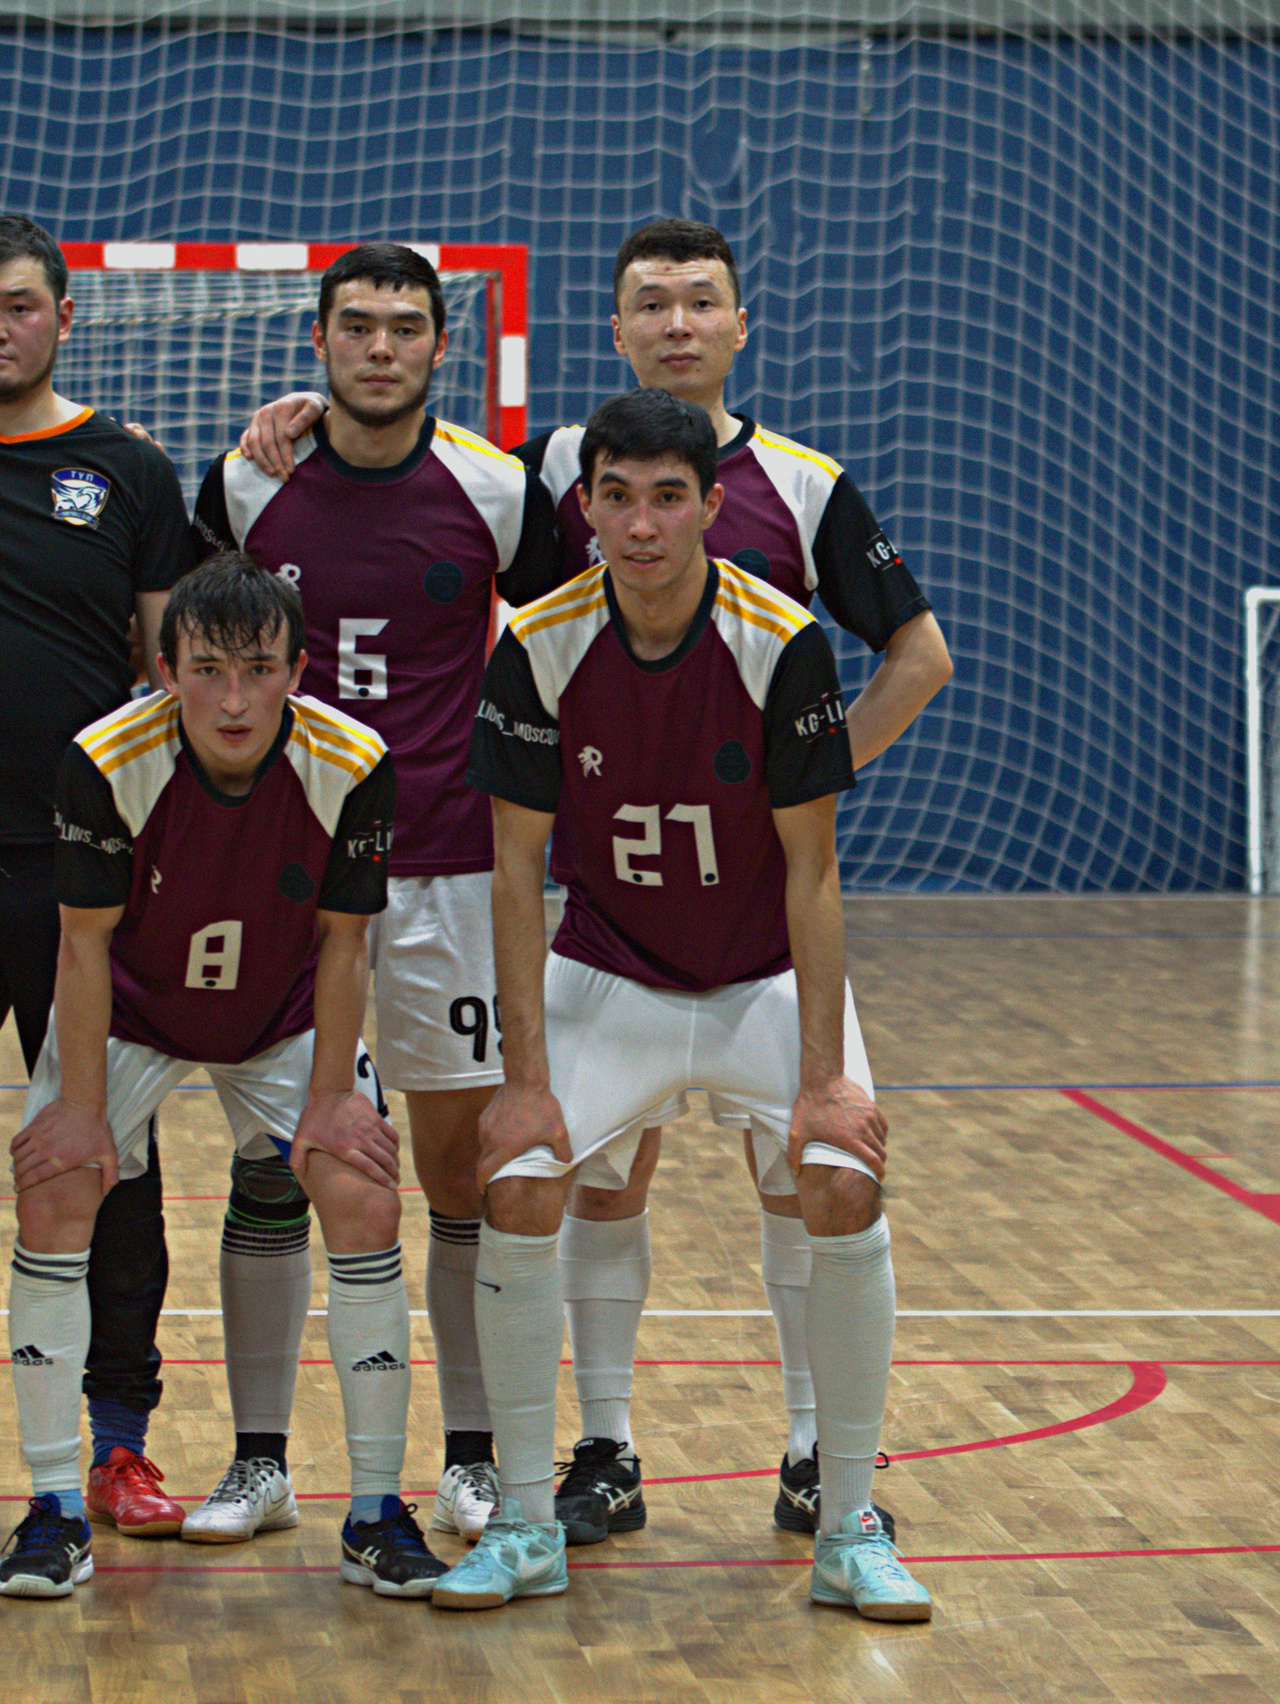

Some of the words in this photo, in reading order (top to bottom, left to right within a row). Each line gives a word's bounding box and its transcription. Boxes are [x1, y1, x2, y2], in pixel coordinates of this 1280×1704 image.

[338, 618, 390, 700] 6
[611, 802, 720, 887] 21
[184, 919, 243, 991] 8
[448, 993, 504, 1063] 9
